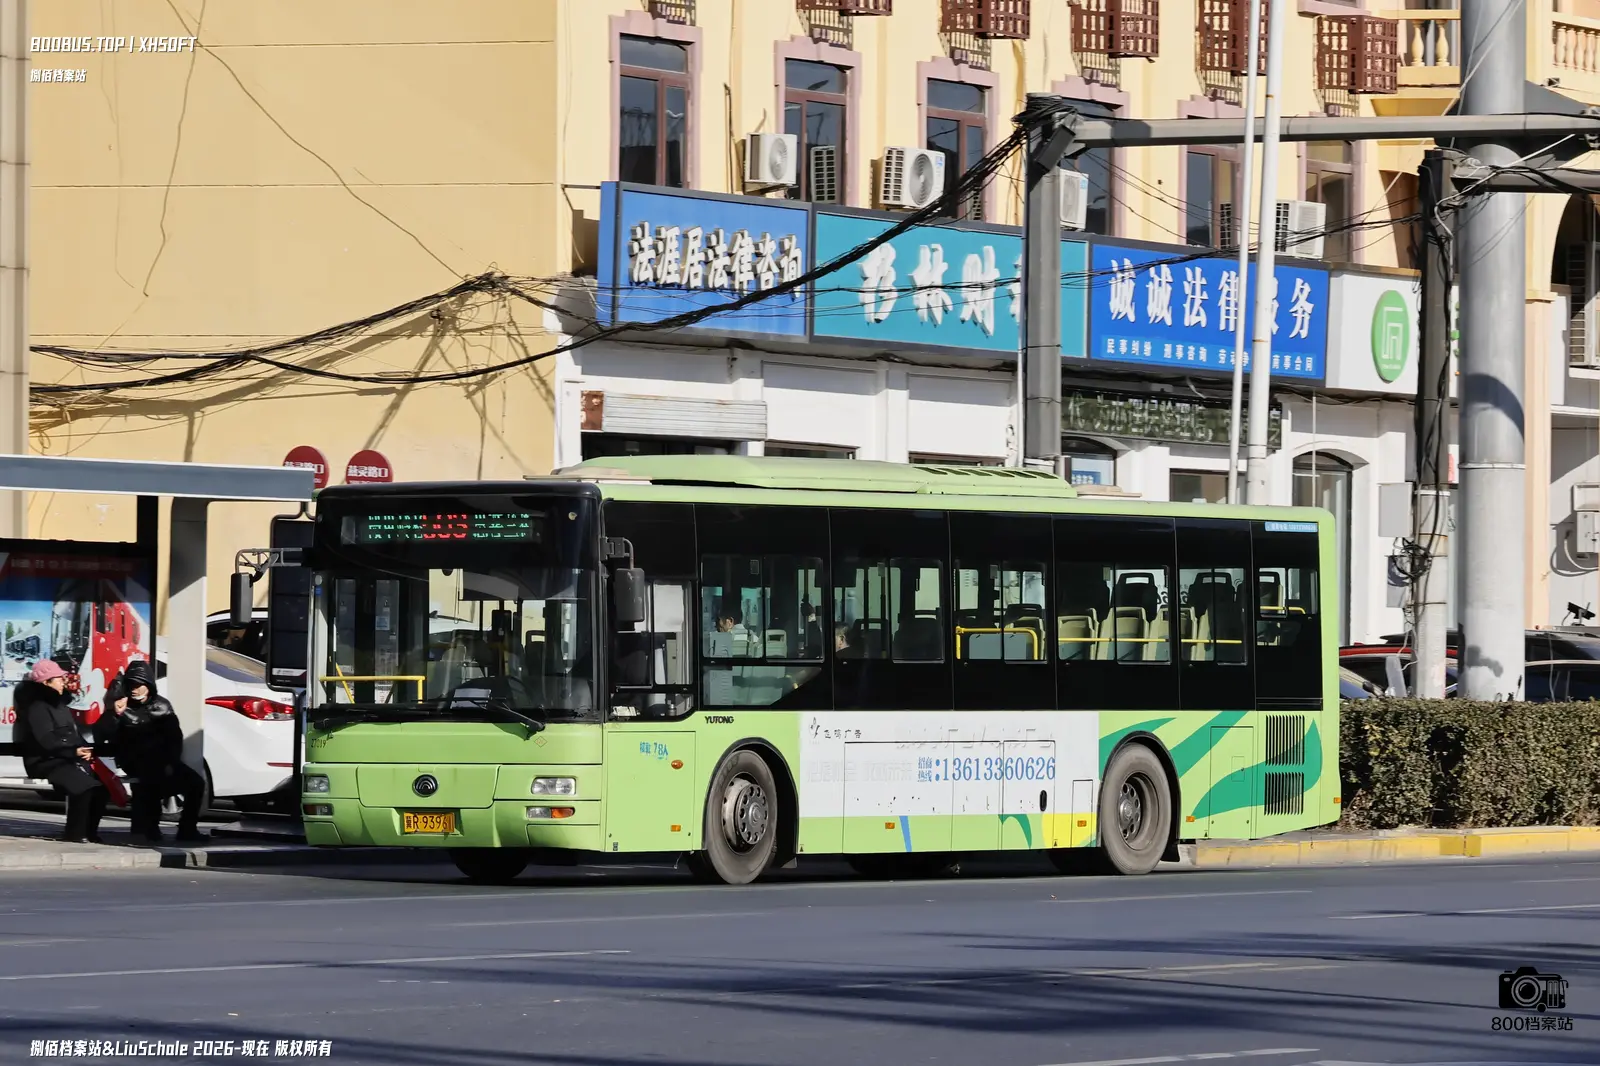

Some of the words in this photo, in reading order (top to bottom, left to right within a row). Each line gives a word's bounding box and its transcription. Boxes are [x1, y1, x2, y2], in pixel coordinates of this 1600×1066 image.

[629, 221, 804, 301] 法涯居法律咨询
[1109, 257, 1315, 339] 诚诚法律务
[704, 715, 735, 725] YUTONG
